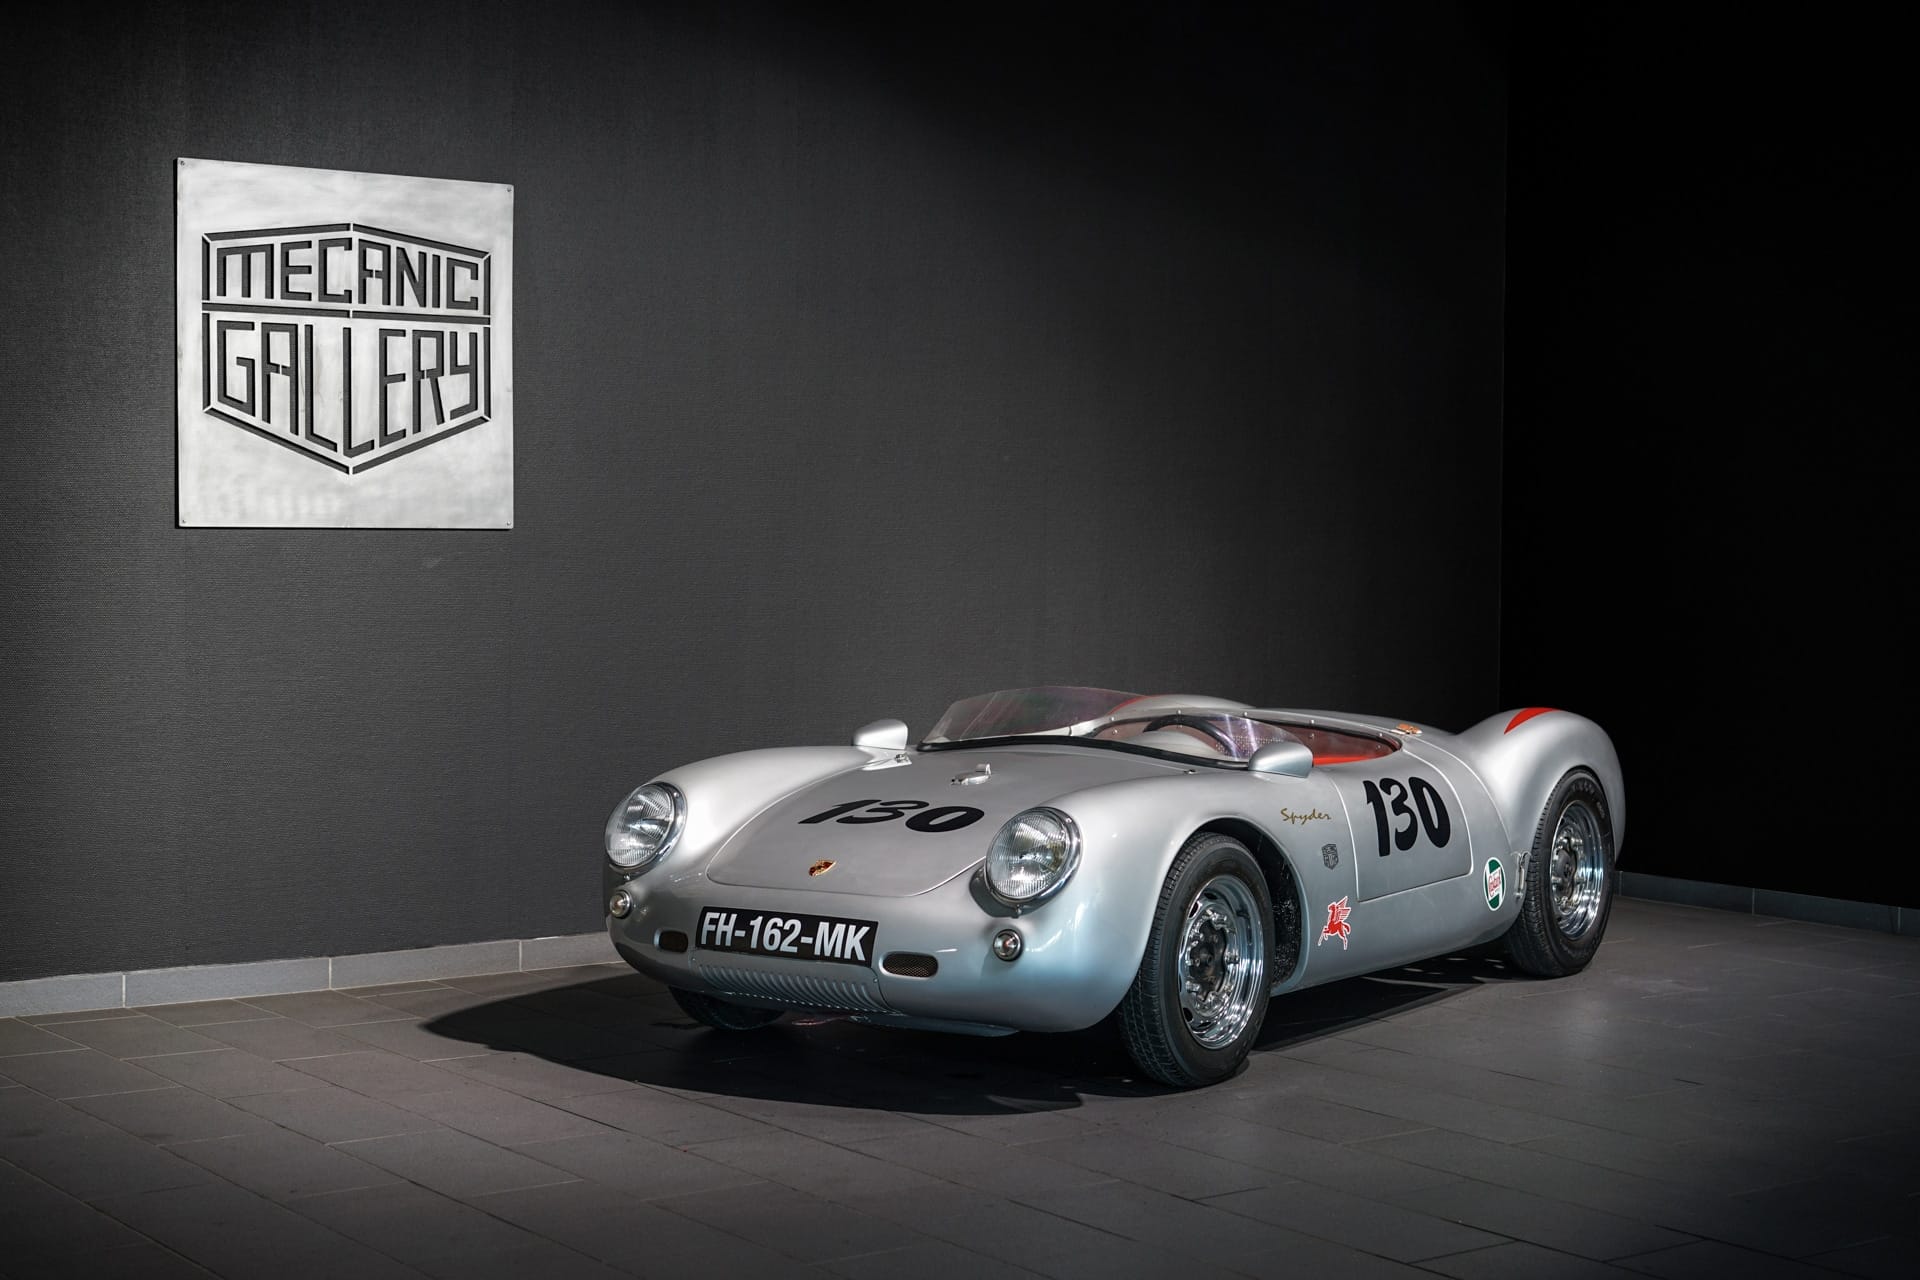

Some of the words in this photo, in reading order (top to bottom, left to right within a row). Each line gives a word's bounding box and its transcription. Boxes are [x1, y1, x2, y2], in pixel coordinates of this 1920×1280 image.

[216, 237, 479, 311] MECANIC
[216, 319, 479, 459] GALLERY
[798, 798, 985, 833] 130
[1280, 807, 1332, 825] Spyder
[1363, 776, 1451, 857] 130
[700, 912, 870, 962] FH-162-MK
